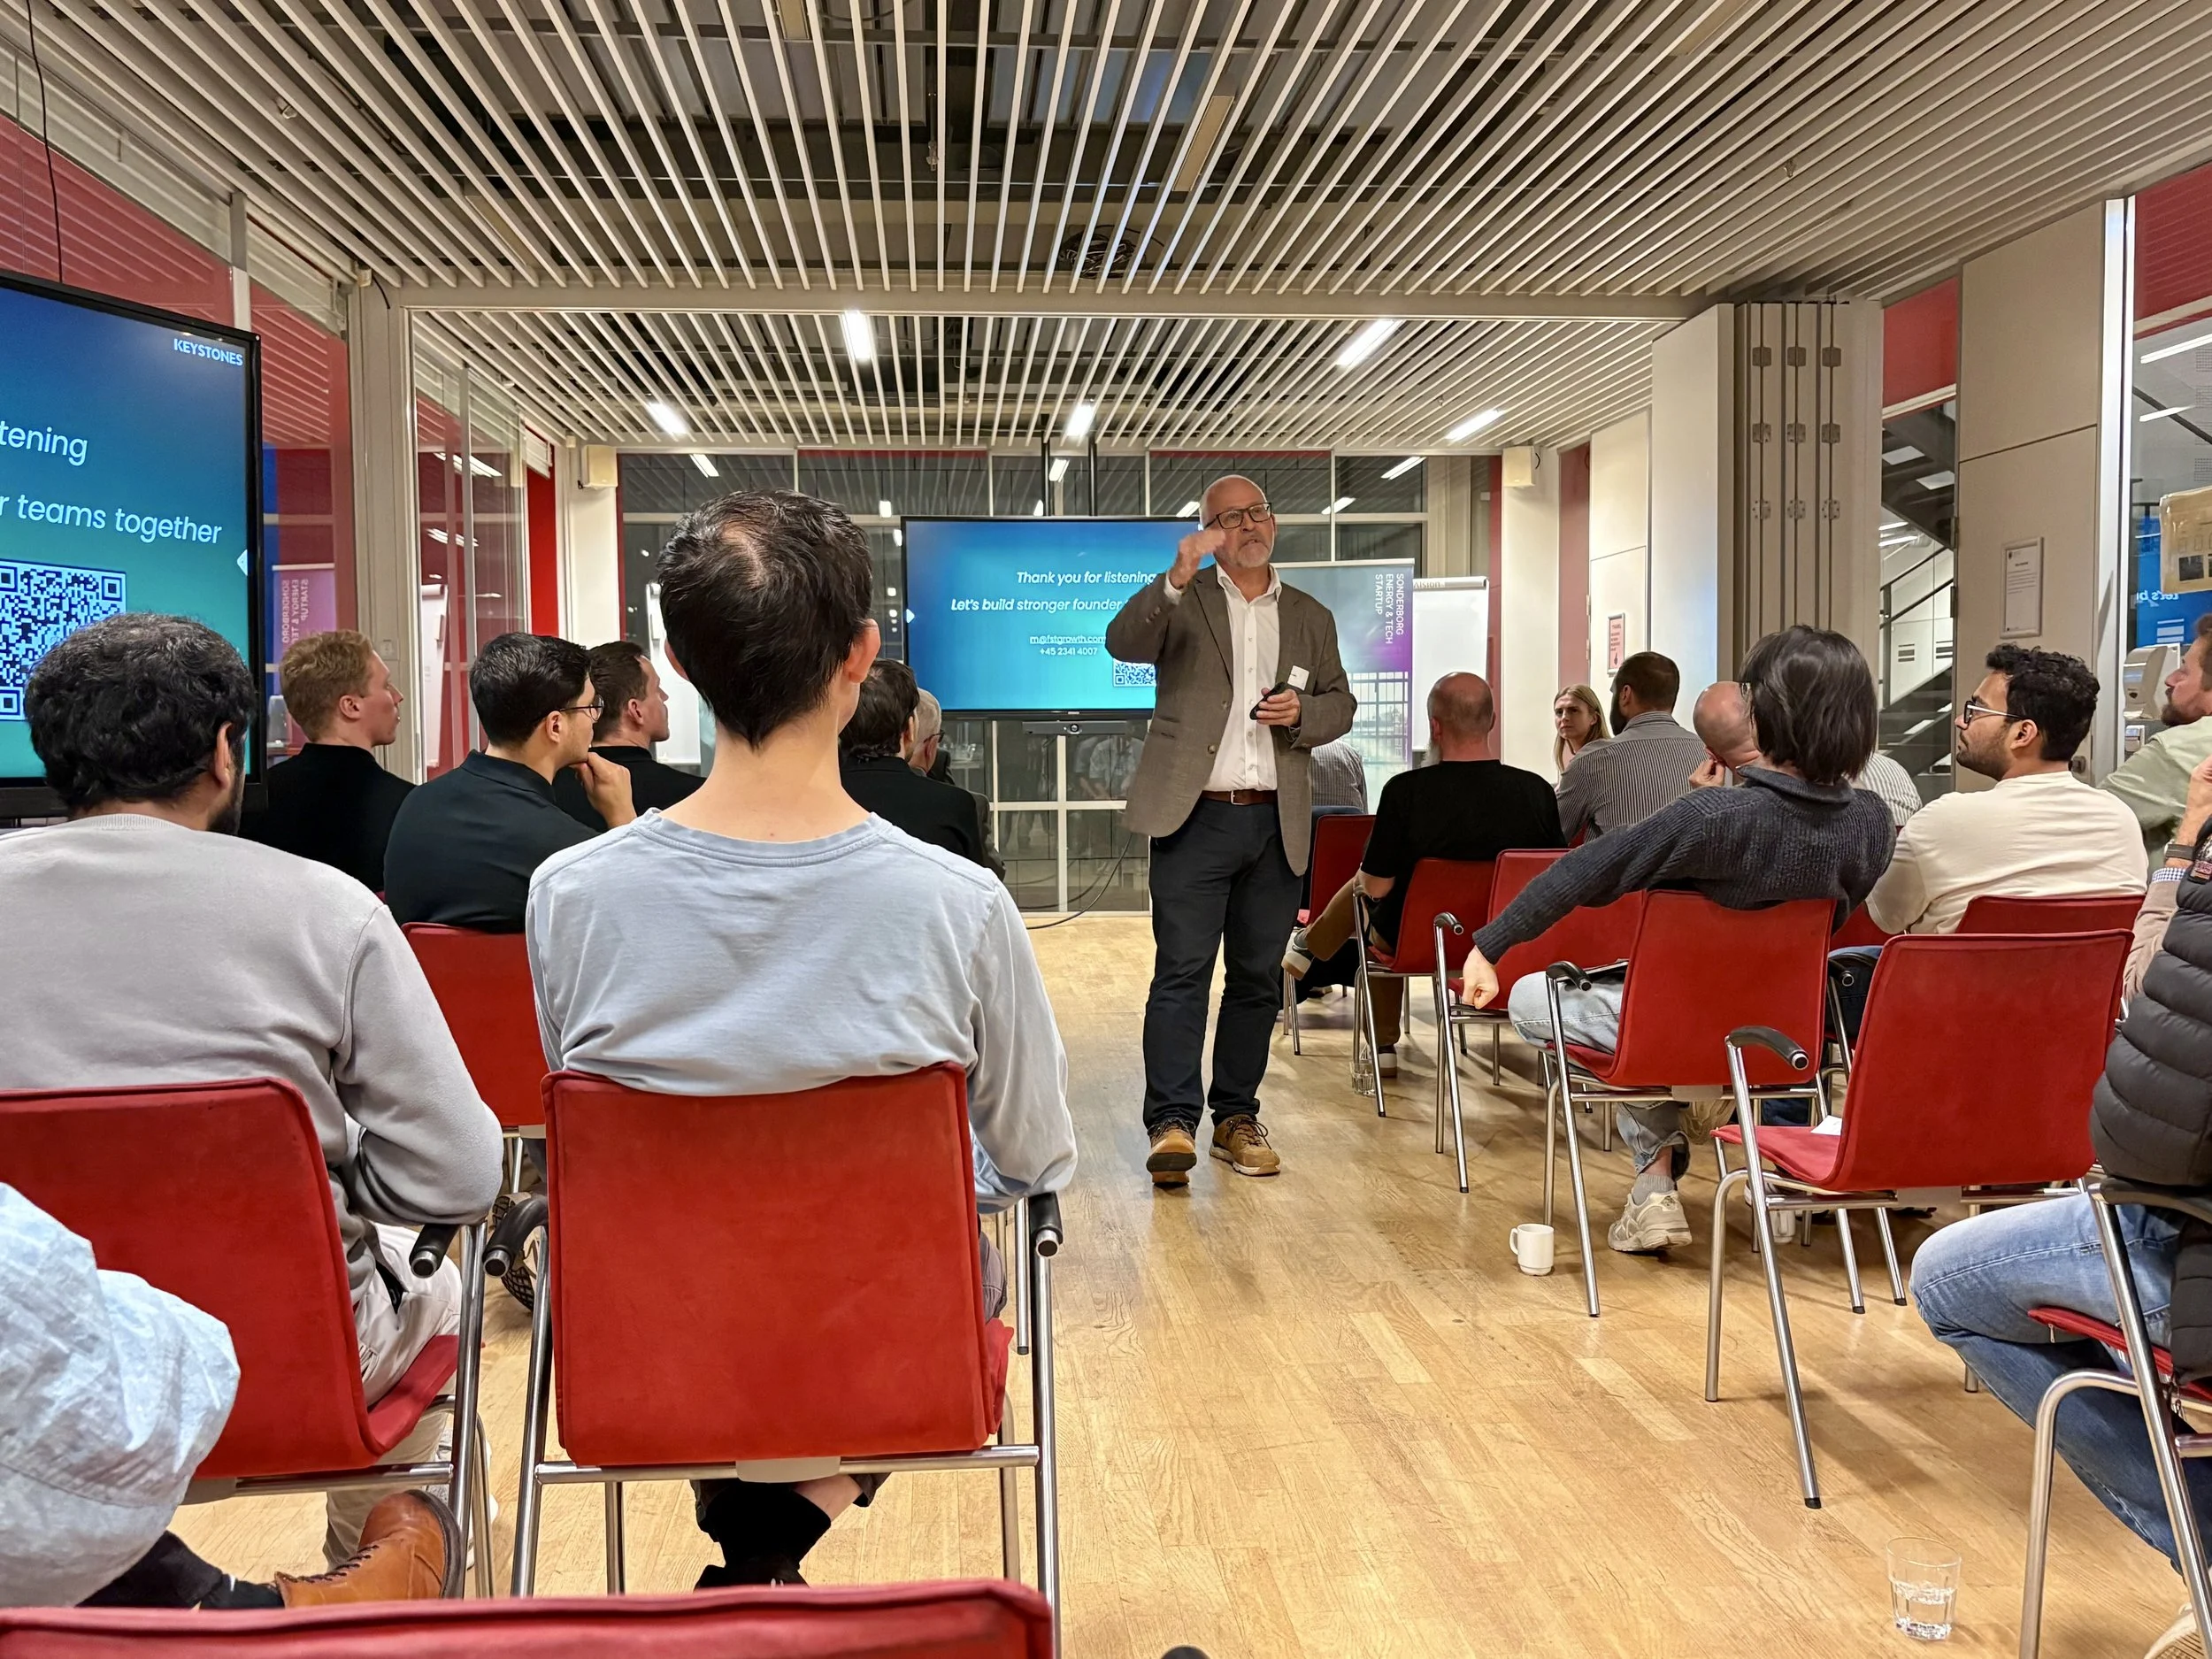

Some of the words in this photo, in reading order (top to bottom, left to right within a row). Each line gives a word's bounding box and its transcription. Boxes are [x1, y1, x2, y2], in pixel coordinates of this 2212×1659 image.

[173, 338, 243, 366] KEYSTONES
[0, 420, 88, 466] tening
[18, 494, 106, 529] teams
[114, 508, 222, 543] together
[1018, 571, 1055, 584] Thank
[1057, 573, 1080, 586] you
[1084, 571, 1102, 584] for
[951, 598, 979, 611] Let's
[982, 598, 1014, 611] build
[1017, 600, 1071, 614] stronger
[1072, 598, 1122, 611] founder
